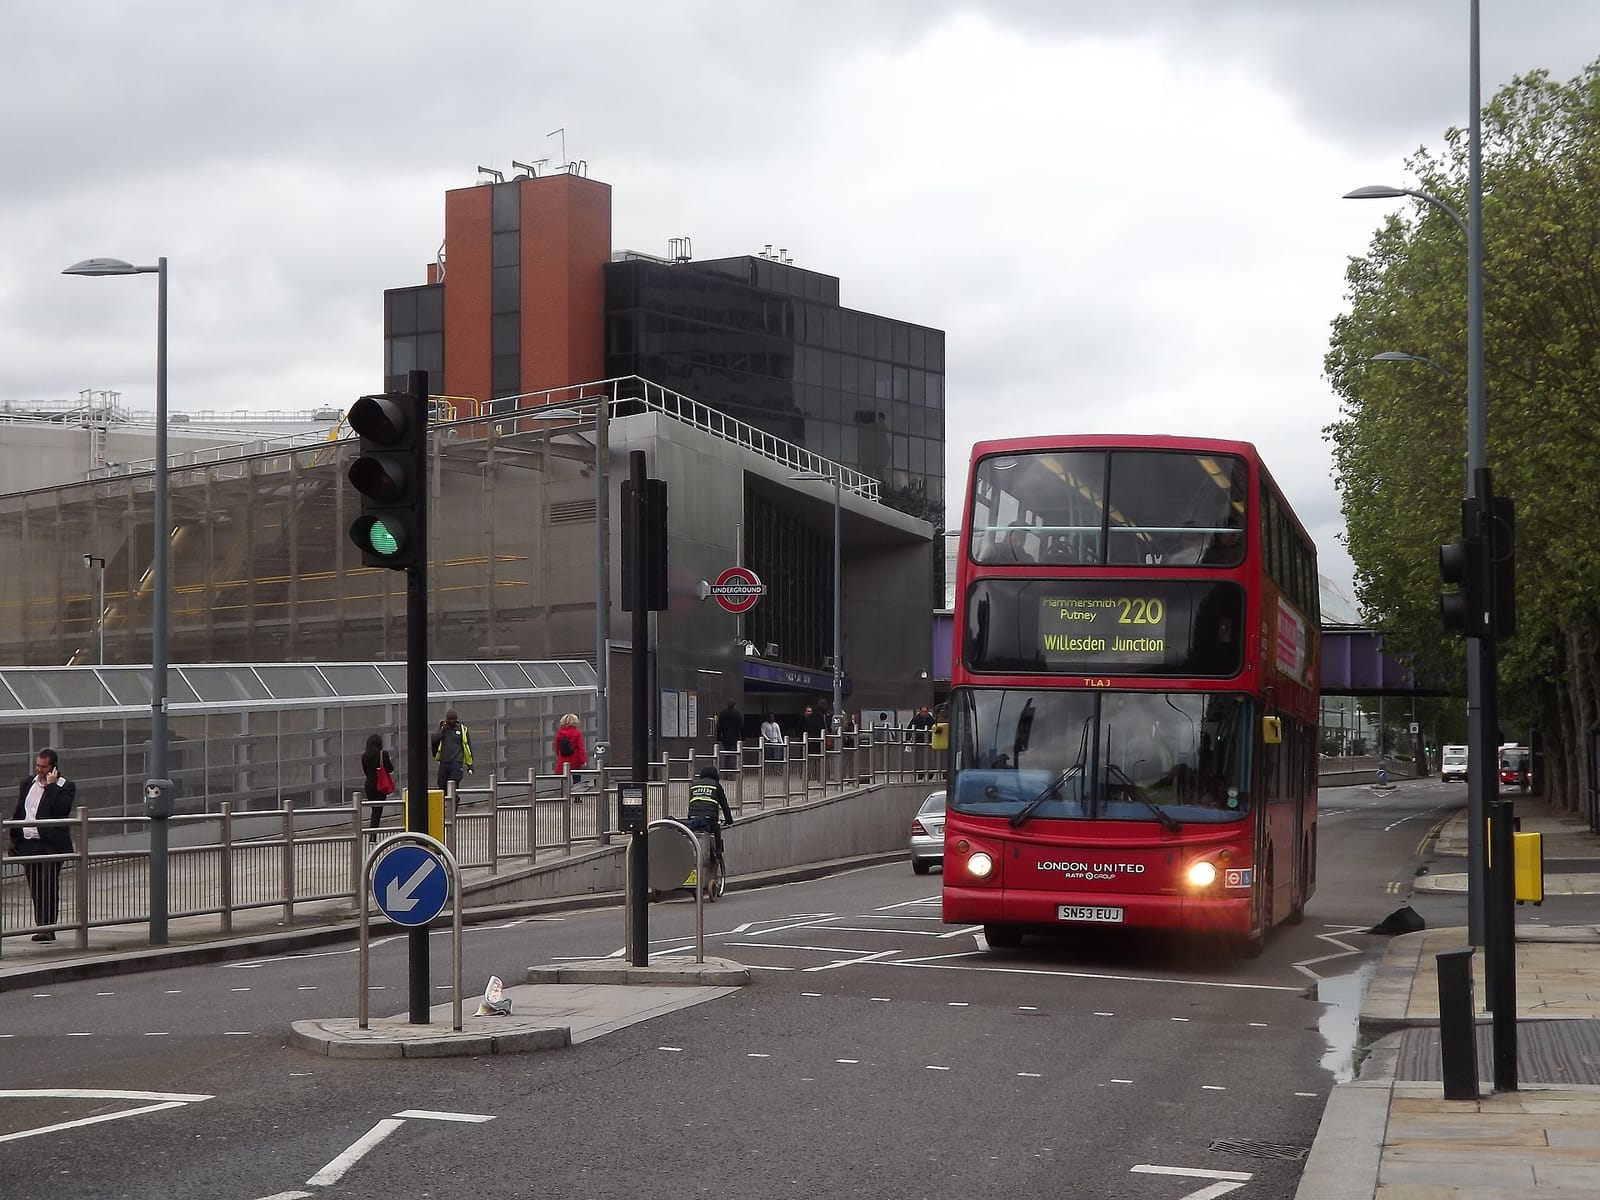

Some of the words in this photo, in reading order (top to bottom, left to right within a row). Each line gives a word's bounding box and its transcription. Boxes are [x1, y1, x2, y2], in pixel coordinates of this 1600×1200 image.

[712, 586, 762, 594] UNDERGROUND
[1060, 609, 1097, 622] Putney
[1118, 599, 1163, 624] 220
[1043, 634, 1105, 652] Willesden
[1111, 635, 1164, 652] Junction
[1083, 678, 1104, 687] TLA
[1105, 679, 1111, 687] 3
[1037, 861, 1089, 871] LONDON
[1093, 863, 1145, 873] UNITED
[1063, 907, 1093, 918] SN53
[1096, 909, 1120, 920] EUJ
